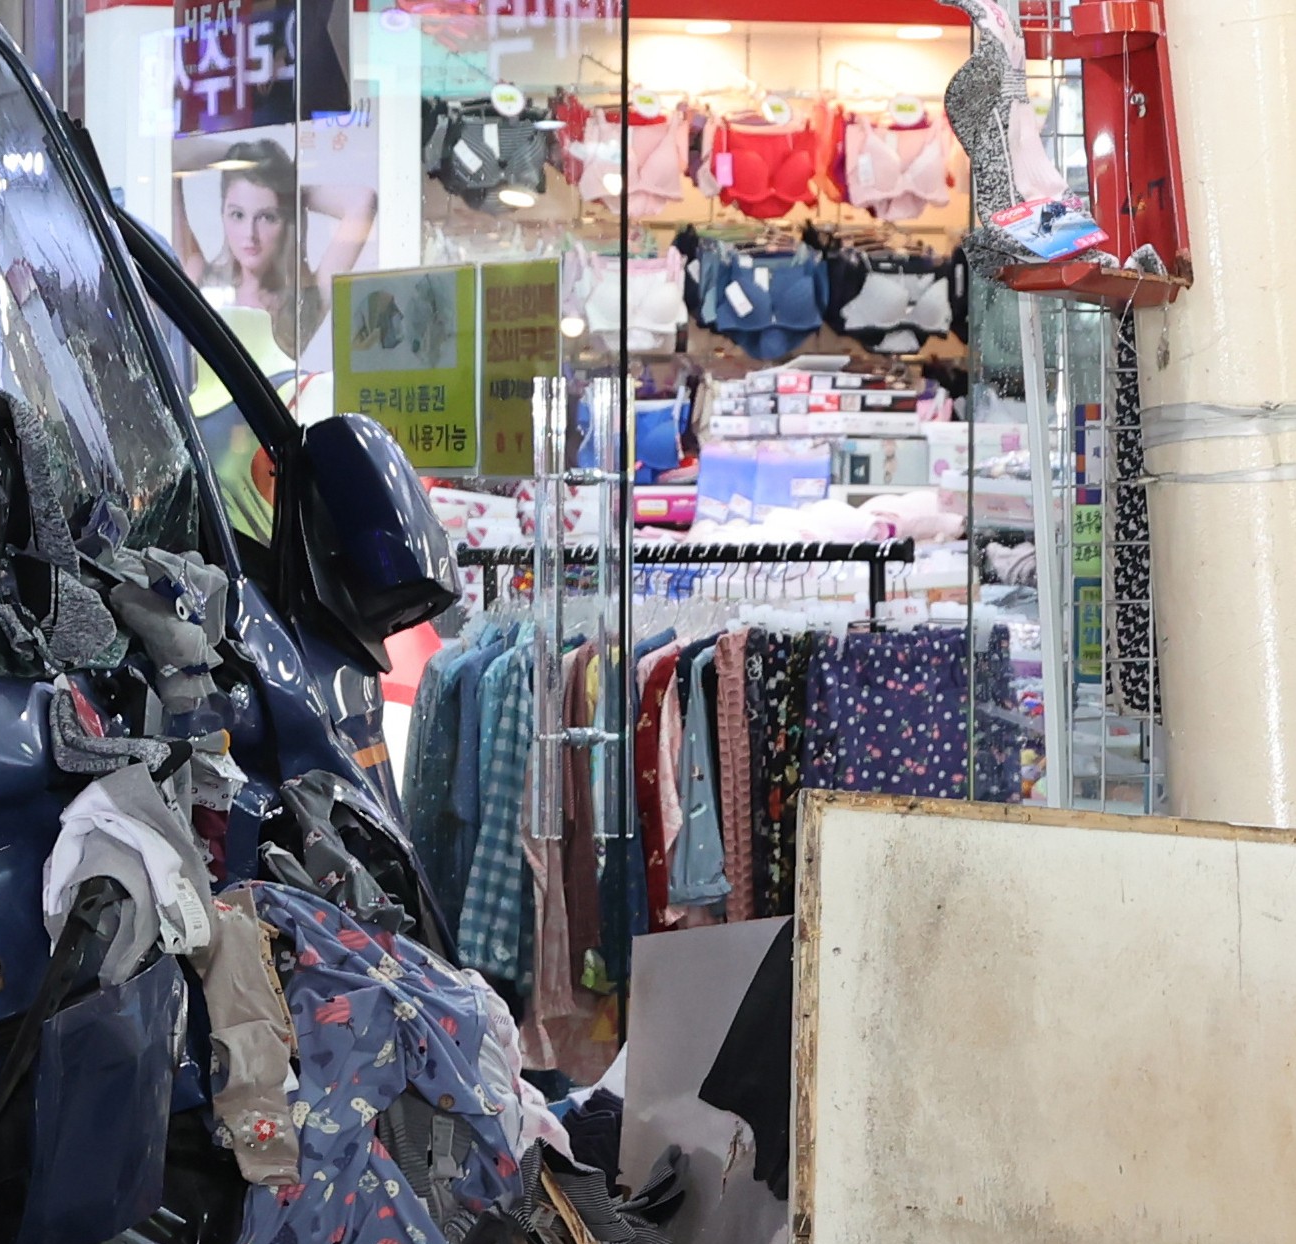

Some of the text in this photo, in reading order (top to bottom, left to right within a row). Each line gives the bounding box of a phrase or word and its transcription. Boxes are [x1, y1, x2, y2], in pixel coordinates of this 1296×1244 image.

[184, 1, 241, 43] HEAT
[359, 385, 446, 414] 온누리상품권
[408, 424, 467, 453] 사용가능
